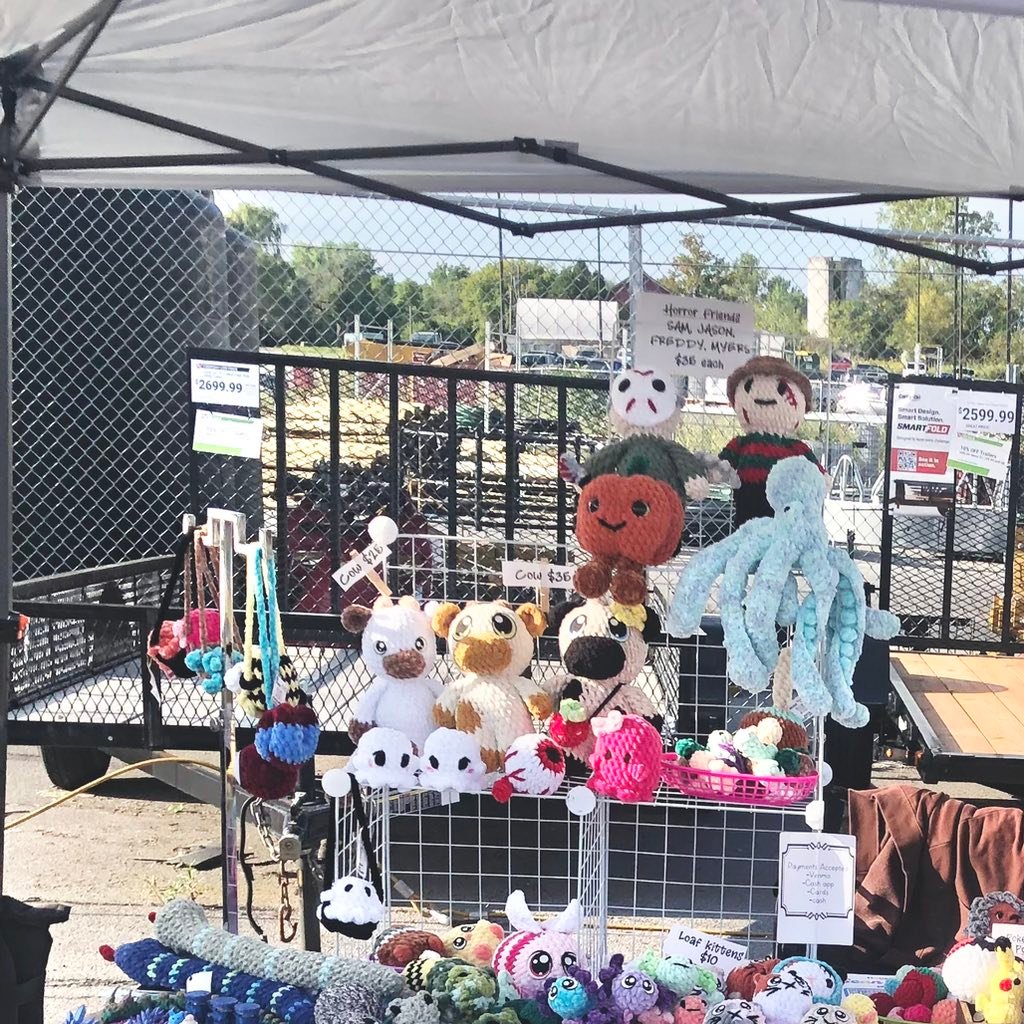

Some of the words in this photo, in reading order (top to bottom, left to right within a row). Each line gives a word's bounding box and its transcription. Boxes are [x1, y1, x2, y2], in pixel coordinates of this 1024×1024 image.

[663, 304, 698, 319] Horror
[703, 309, 741, 324] Friends
[697, 325, 736, 338] JASON,
[650, 336, 708, 352] FREDDY,
[711, 342, 750, 354] MYERS
[701, 359, 724, 370] each
[958, 406, 1014, 424] $2599.99
[896, 422, 948, 434] SMARTFOLD
[340, 564, 362, 586] Cow
[515, 570, 542, 580] Cow
[678, 930, 702, 947] Loaf
[705, 940, 744, 962] kittens
[700, 950, 718, 966] $10
